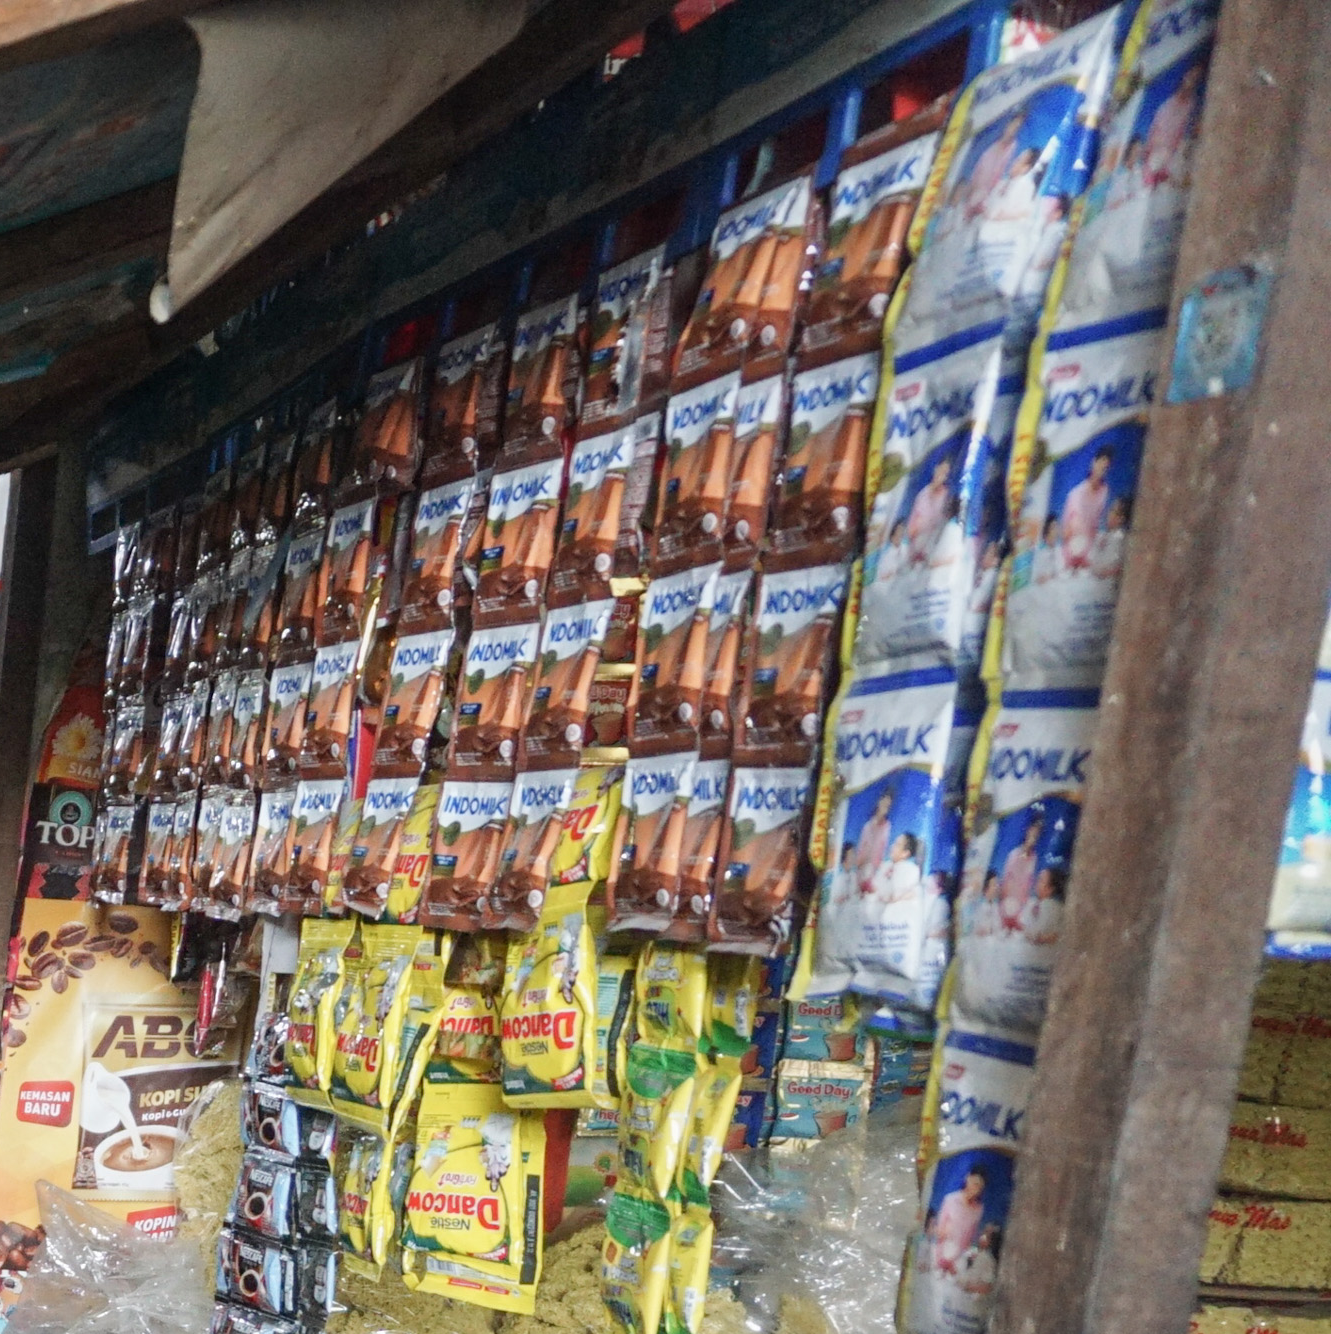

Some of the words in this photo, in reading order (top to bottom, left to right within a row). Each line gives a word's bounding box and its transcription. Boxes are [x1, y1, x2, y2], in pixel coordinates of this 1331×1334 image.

[36, 820, 96, 849] TOP
[19, 1090, 71, 1103] KEMASAN
[139, 1088, 182, 1109] KOPI
[787, 1081, 817, 1095] Good
[819, 1082, 853, 1100] Day
[23, 1102, 61, 1117] BARU
[407, 1191, 501, 1231] Dancow
[1245, 1204, 1292, 1231] Mas
[135, 1213, 177, 1231] KOPIN
